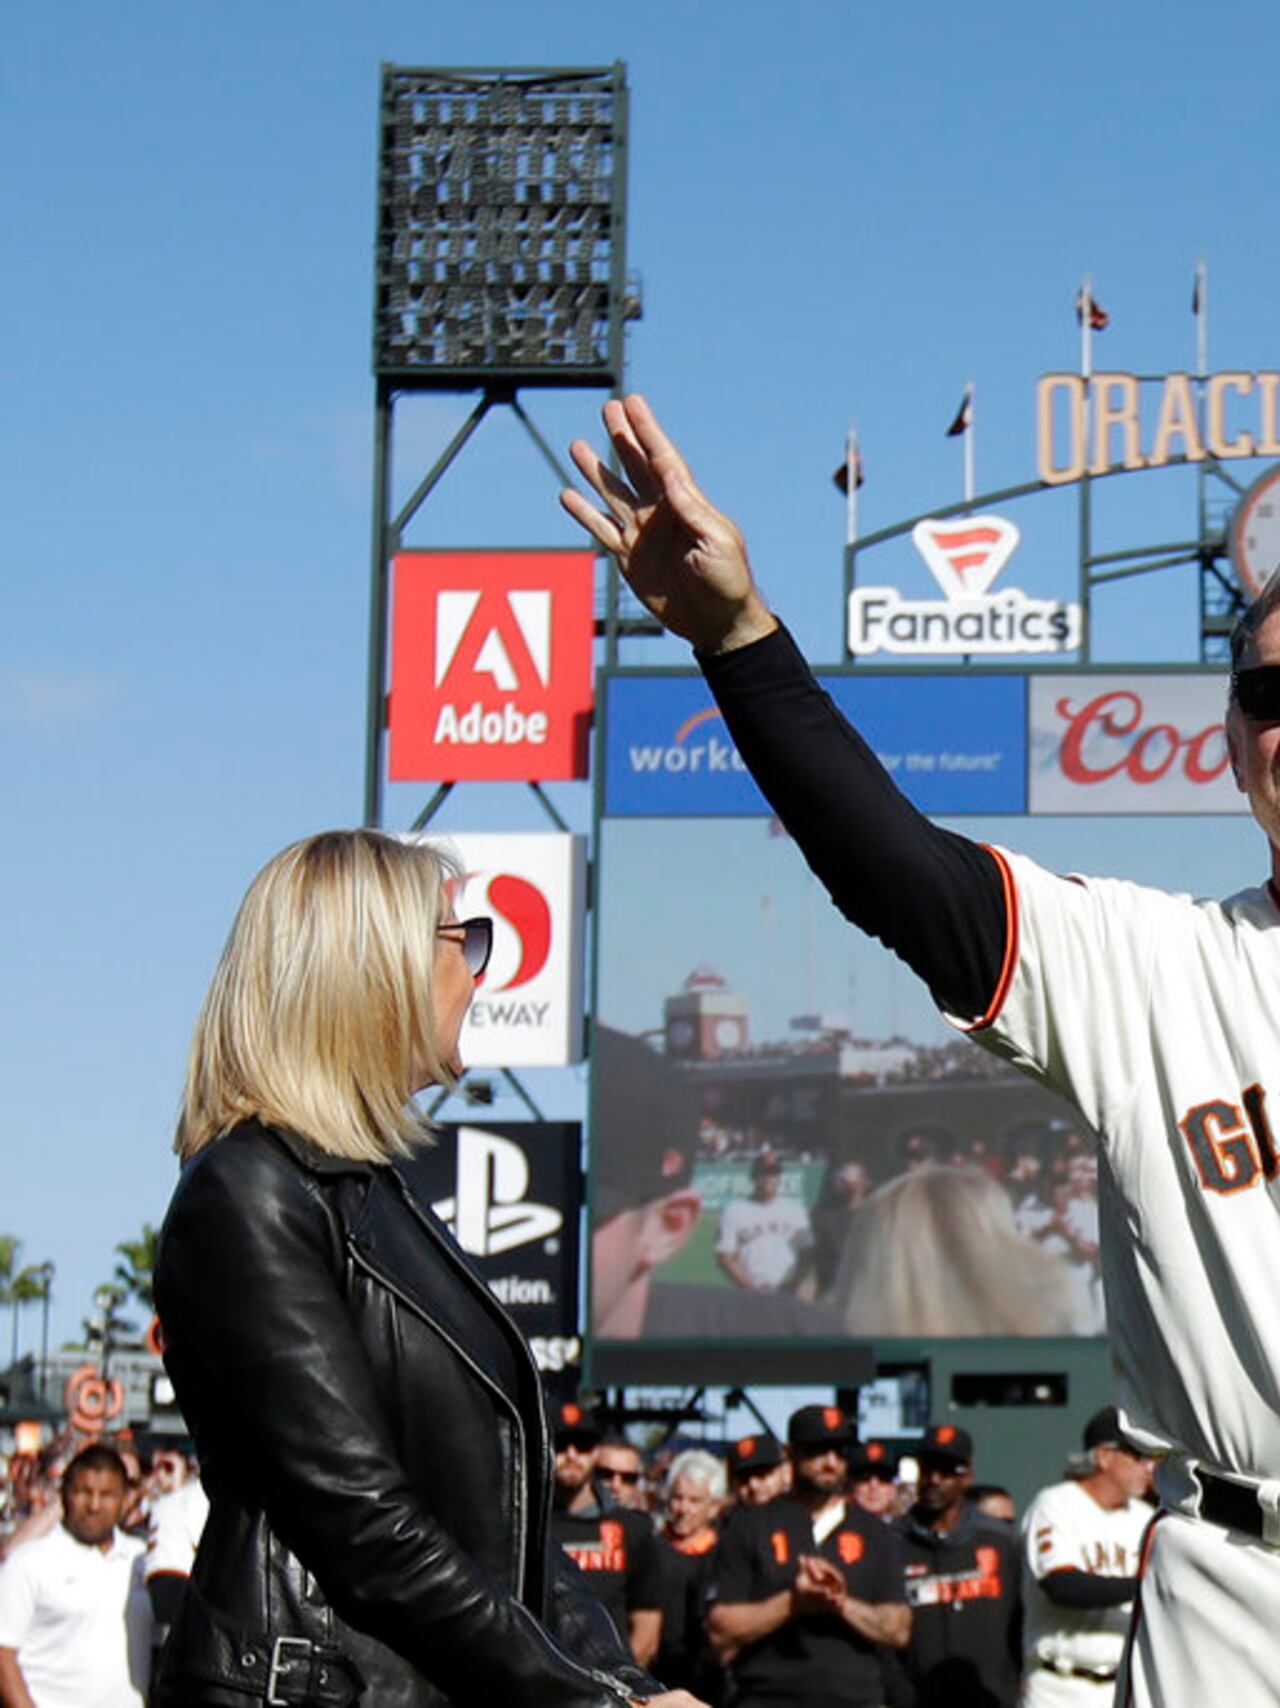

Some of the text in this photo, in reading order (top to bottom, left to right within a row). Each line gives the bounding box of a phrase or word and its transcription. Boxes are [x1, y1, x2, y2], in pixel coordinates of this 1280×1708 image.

[860, 599, 1070, 643] Fanatics
[433, 702, 548, 744] Adobe
[1055, 690, 1230, 785] Coo
[629, 738, 747, 773] work
[469, 1001, 551, 1029] EWAY
